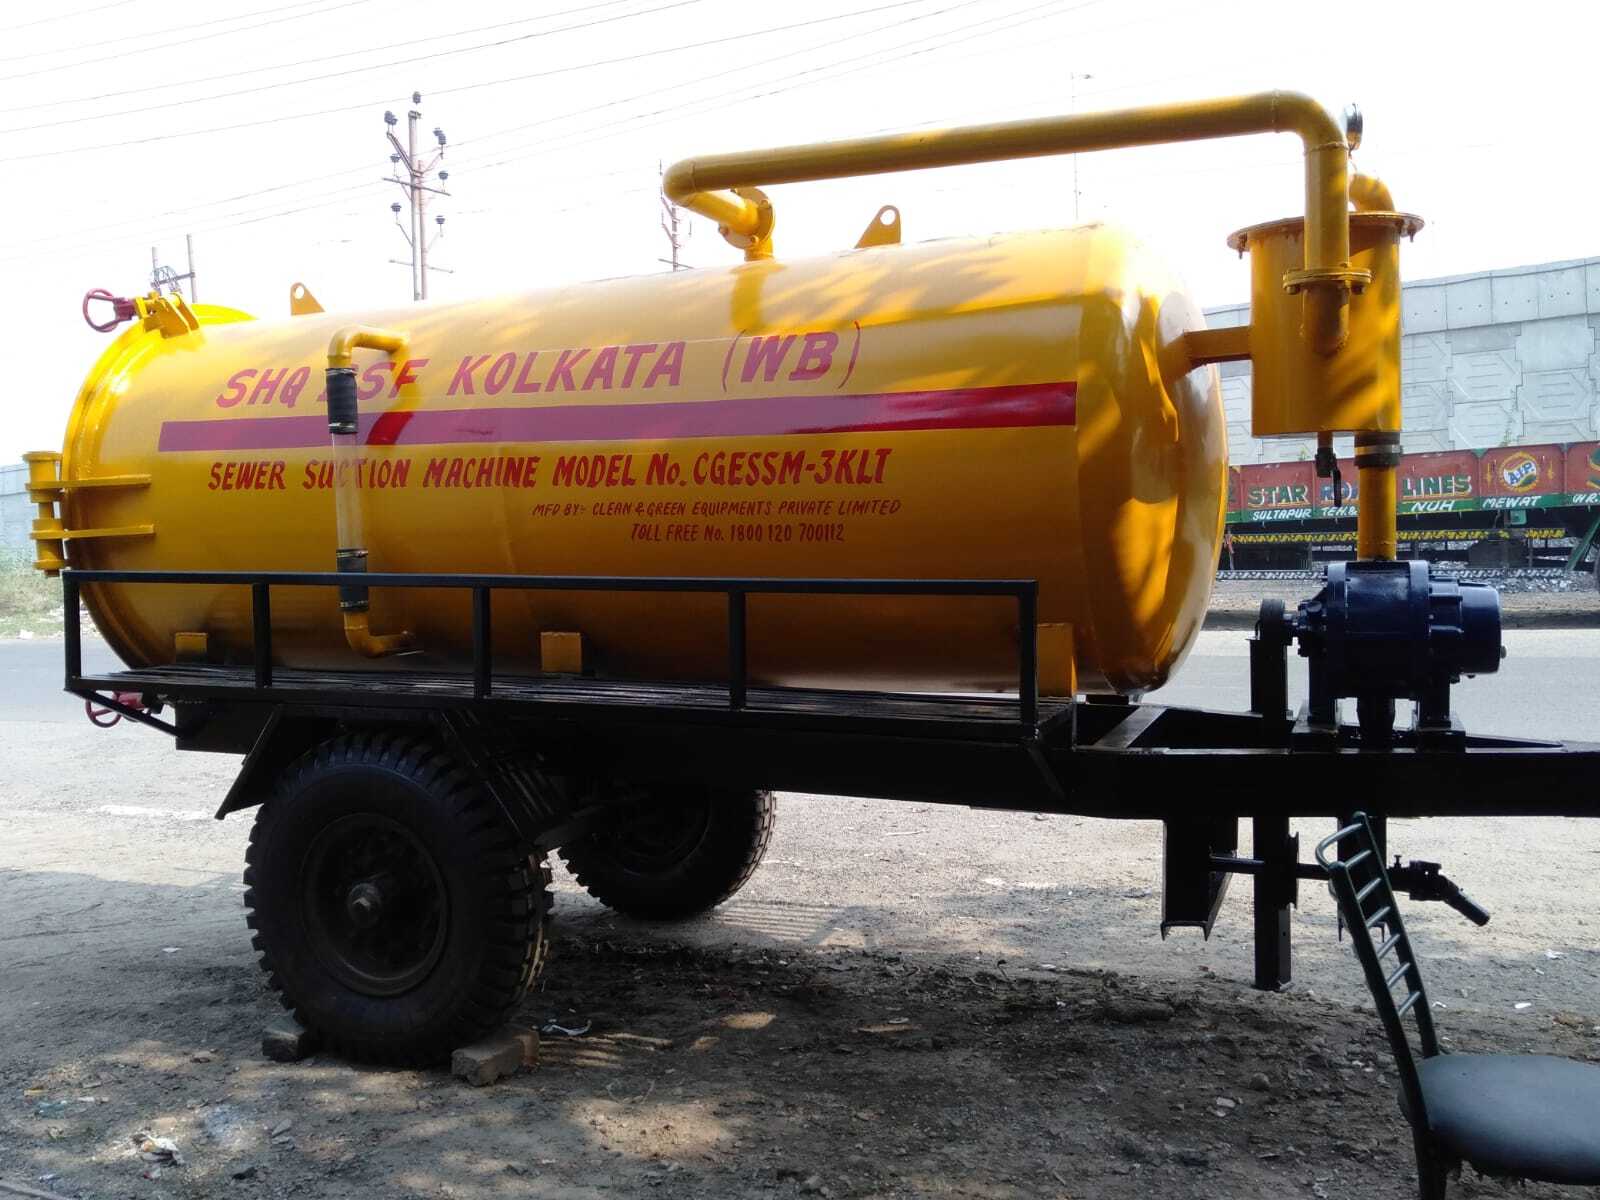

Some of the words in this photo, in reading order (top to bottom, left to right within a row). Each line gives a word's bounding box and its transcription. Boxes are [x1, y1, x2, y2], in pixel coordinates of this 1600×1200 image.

[216, 366, 311, 408] SHQ
[446, 341, 686, 396] KOLKATA
[721, 321, 861, 392] (WB)
[208, 461, 286, 490] SEWER
[302, 458, 412, 489] SUCTION
[422, 456, 541, 489] MACHINE
[552, 453, 637, 489] MODEL
[645, 452, 686, 487] No.
[693, 448, 893, 487] CGESSM-3KLT
[1248, 483, 1311, 506] STAR
[1402, 474, 1473, 497] LINES
[532, 503, 561, 516] MFD
[592, 502, 632, 516] CLEAN
[647, 502, 687, 516] GREEN
[692, 501, 772, 517] EQUIPMENTS
[778, 500, 833, 515] PRIVATE
[838, 499, 902, 515] LIMITED
[1253, 507, 1313, 521] SULTAPUR
[1411, 500, 1456, 512] NUH
[1482, 496, 1542, 509] MEWAT
[631, 523, 662, 542] TOLL
[666, 523, 700, 542] FREE
[703, 524, 725, 542] No.
[730, 523, 763, 542] 1800
[768, 523, 792, 542] 120
[799, 523, 845, 542] 700112
